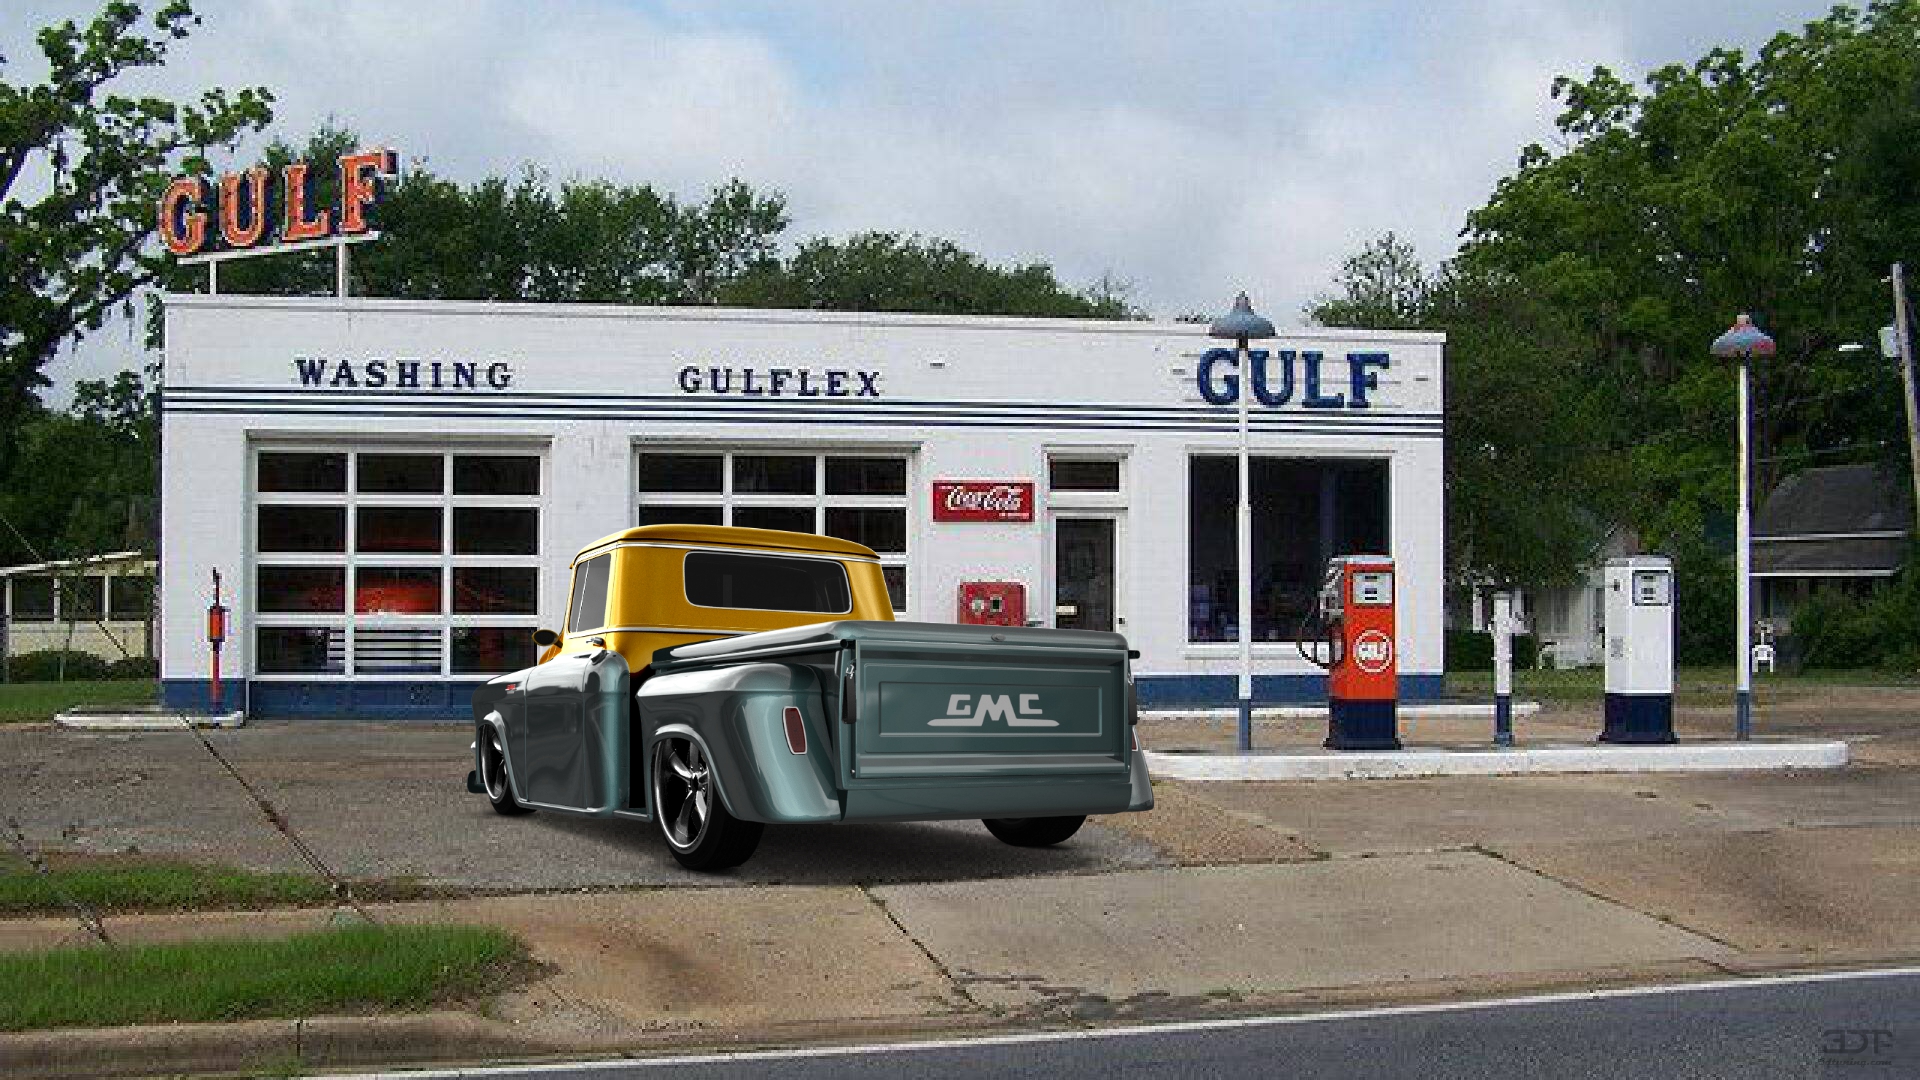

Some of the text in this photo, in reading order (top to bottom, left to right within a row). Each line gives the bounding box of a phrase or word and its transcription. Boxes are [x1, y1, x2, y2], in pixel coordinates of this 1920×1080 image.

[158, 149, 397, 253] GULF
[293, 359, 511, 390] WASHING
[679, 366, 880, 396] GULFLEX
[1197, 348, 1389, 408] GULF
[927, 693, 1060, 727] GMC
